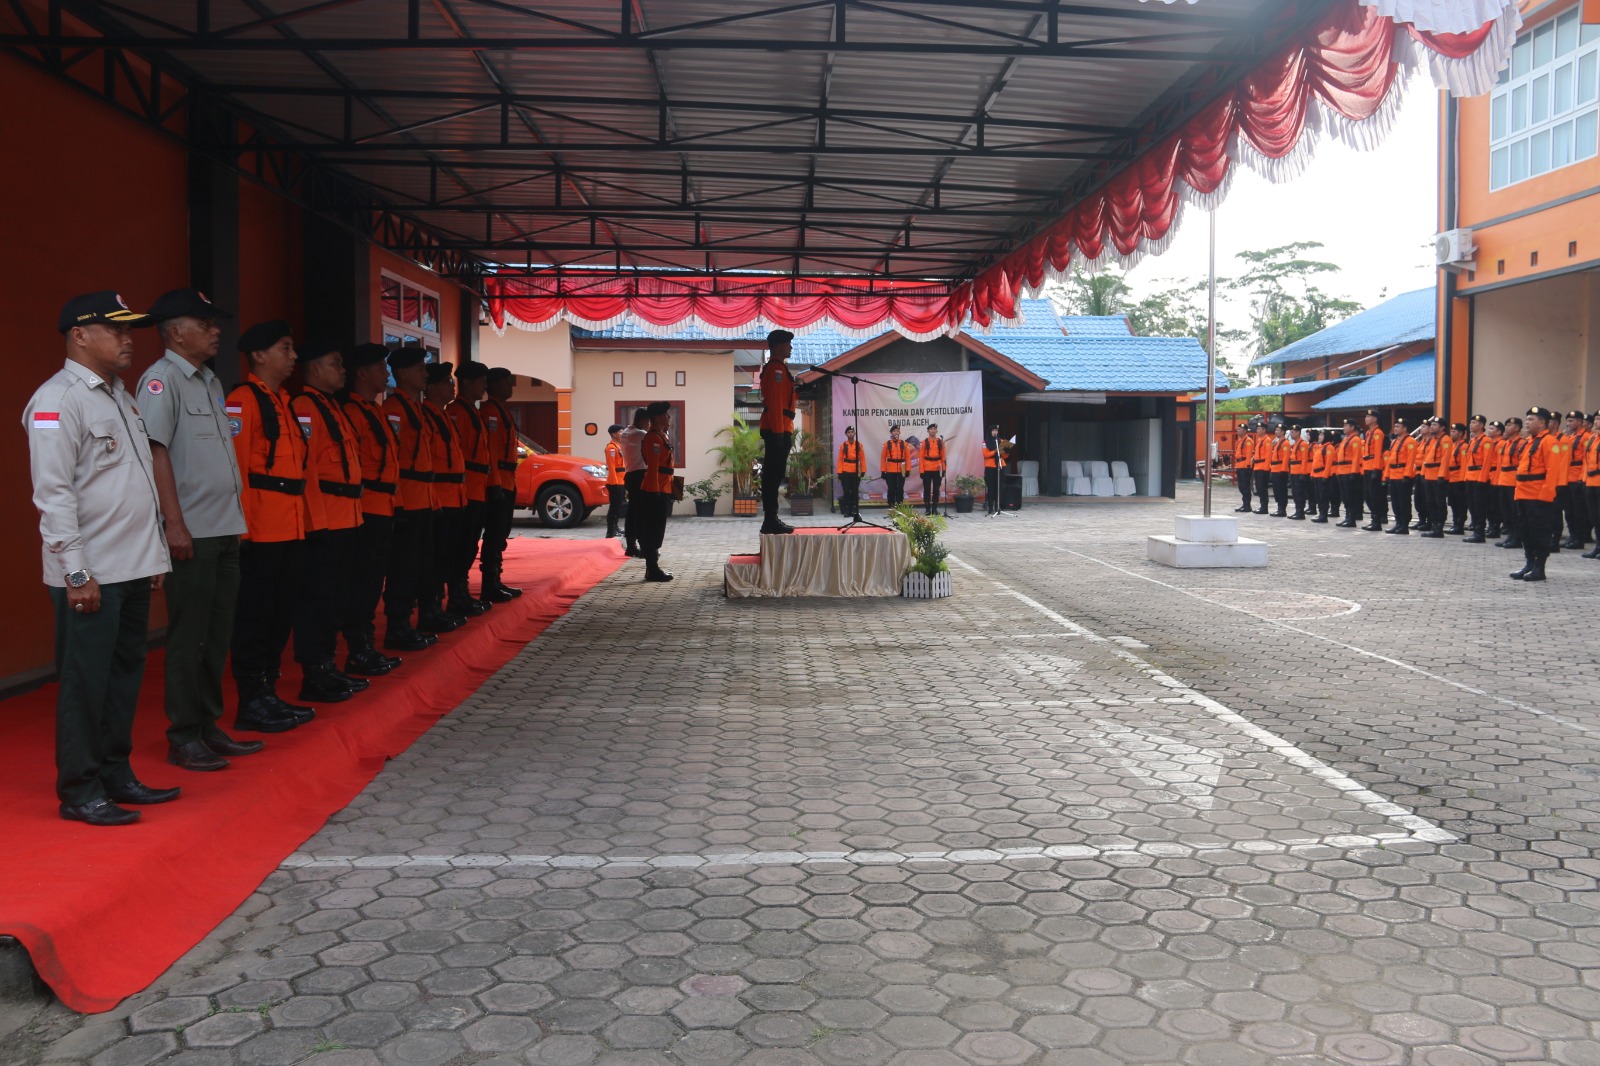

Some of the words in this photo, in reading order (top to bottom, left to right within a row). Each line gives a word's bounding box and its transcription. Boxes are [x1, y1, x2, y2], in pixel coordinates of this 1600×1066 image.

[842, 408, 870, 416] KANTOR
[871, 408, 909, 416] PENCARIAN
[910, 407, 924, 416] DAN
[926, 406, 973, 415] PERTOLONGAN
[888, 419, 911, 427] BANDA
[912, 418, 930, 426] ACEH
